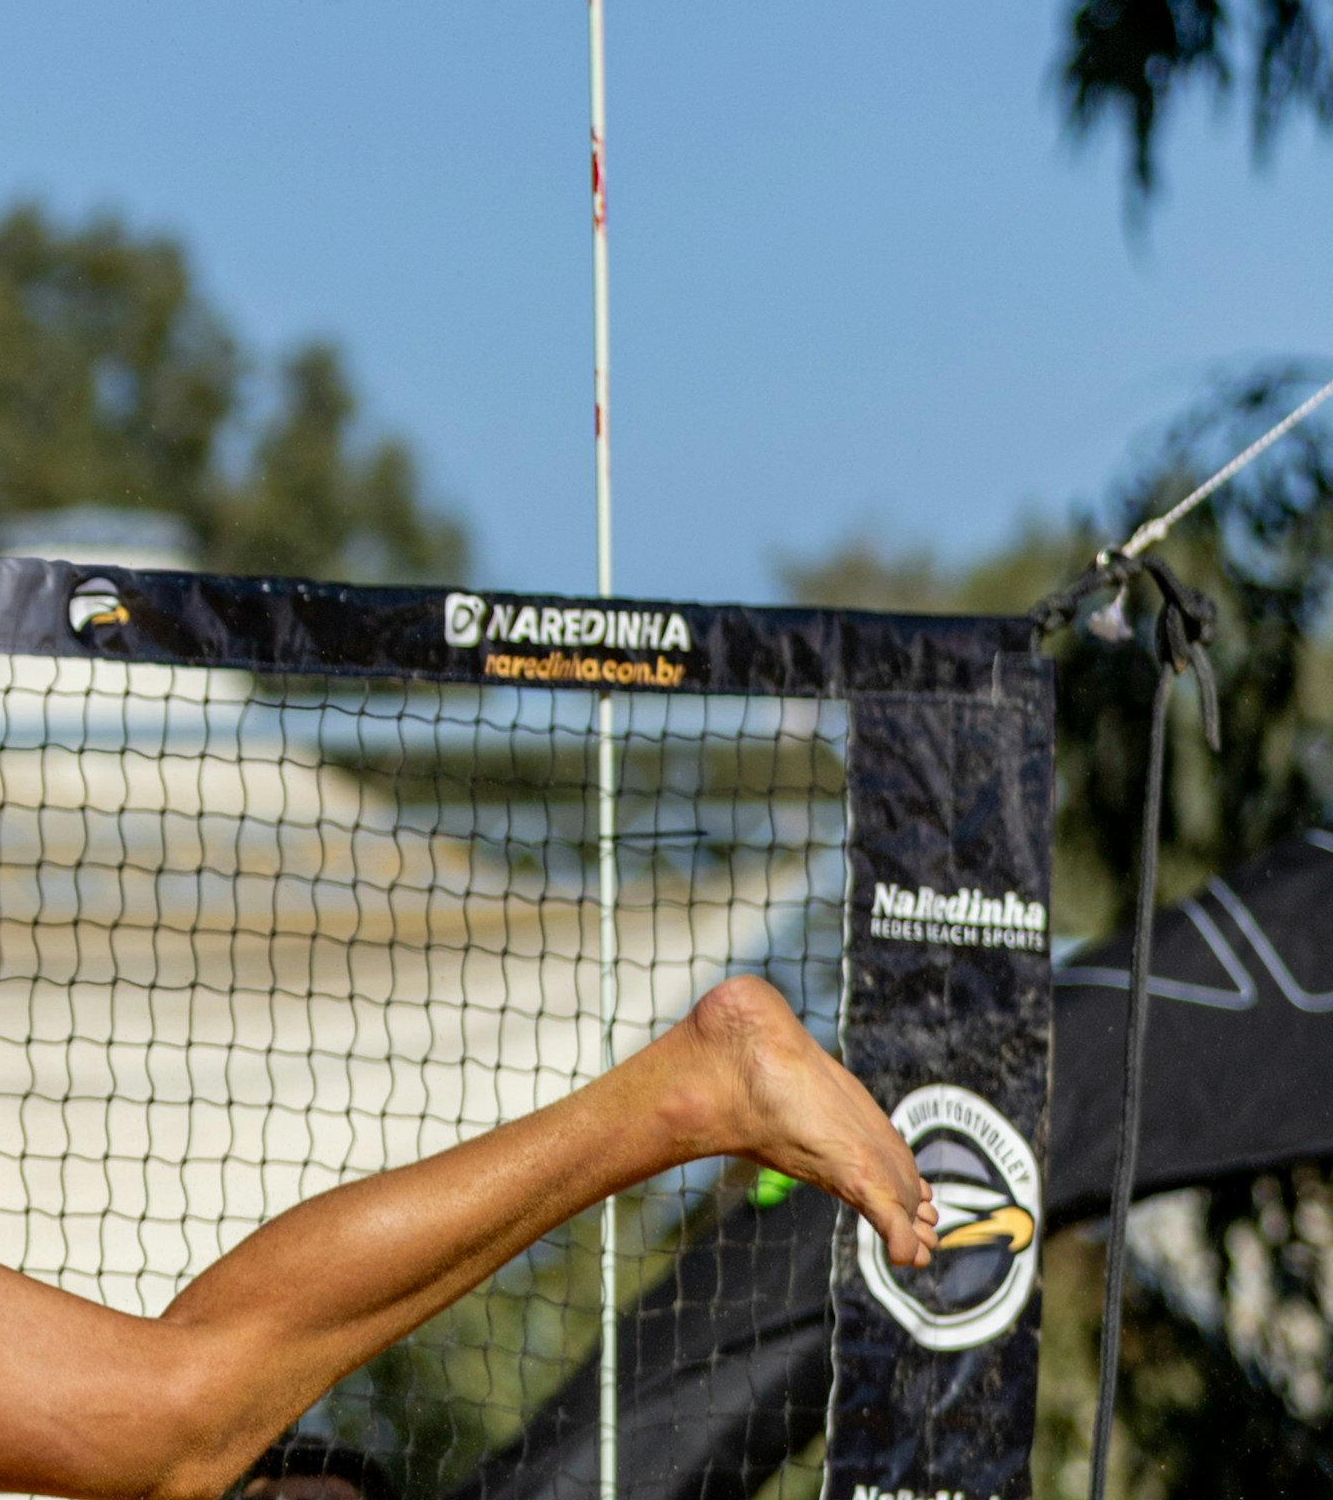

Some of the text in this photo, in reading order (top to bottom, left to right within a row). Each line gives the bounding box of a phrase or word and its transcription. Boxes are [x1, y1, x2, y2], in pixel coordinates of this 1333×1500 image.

[486, 604, 692, 653] NAREDINHA
[871, 882, 1047, 932] NaRedinha
[870, 916, 925, 942] REDES
[981, 927, 1046, 952] SPORTS
[945, 1099, 1031, 1184] FOOTVOLLEY
